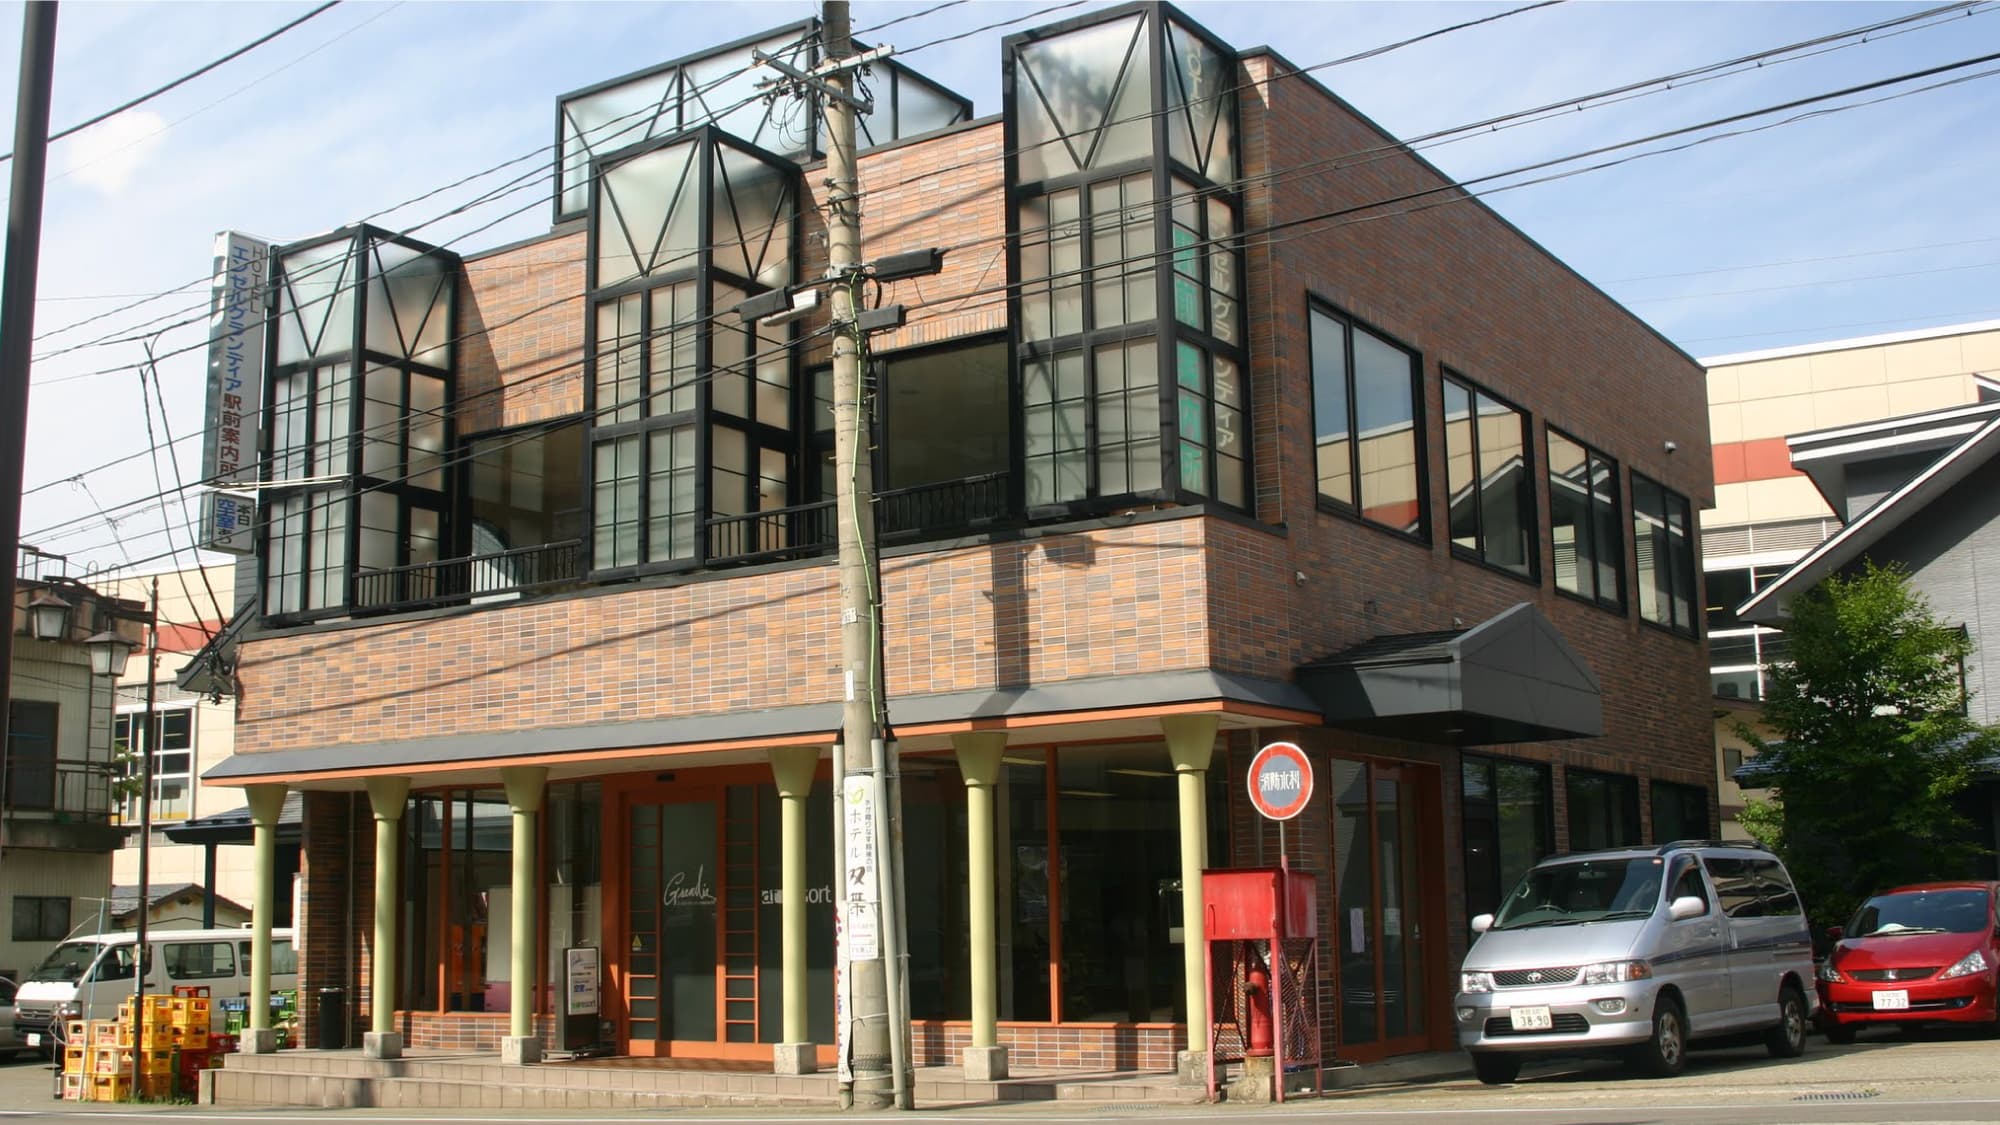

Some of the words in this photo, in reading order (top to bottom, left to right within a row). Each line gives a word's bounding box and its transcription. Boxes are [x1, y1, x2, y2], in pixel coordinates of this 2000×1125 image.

[250, 246, 263, 314] HOTEL
[1259, 770, 1300, 792] 消防水利
